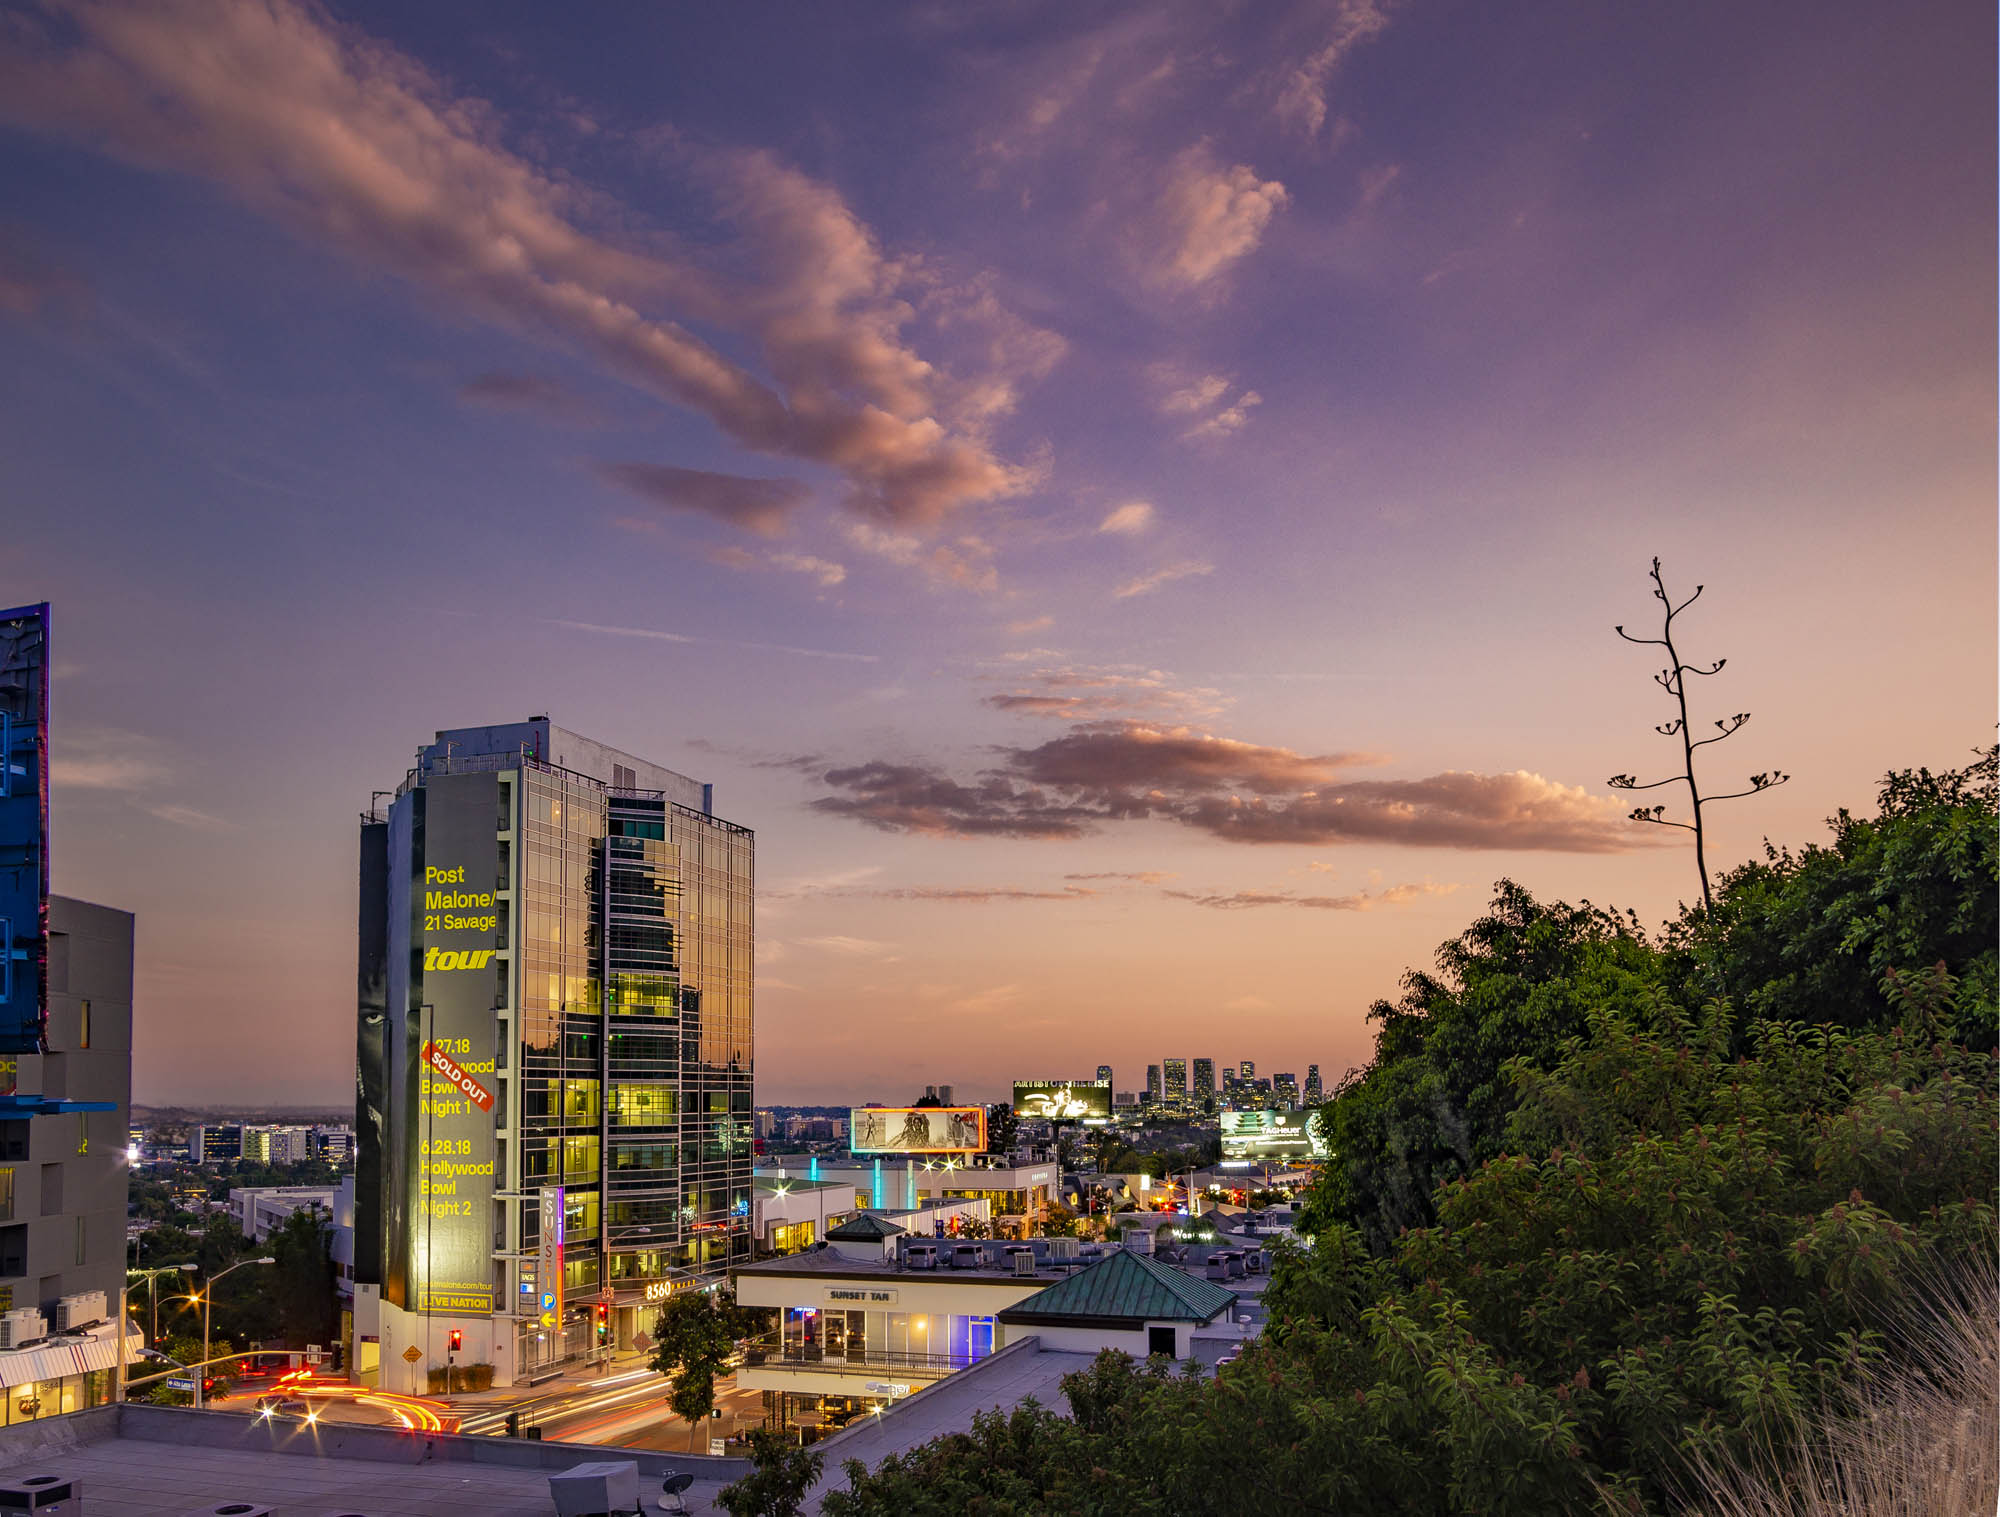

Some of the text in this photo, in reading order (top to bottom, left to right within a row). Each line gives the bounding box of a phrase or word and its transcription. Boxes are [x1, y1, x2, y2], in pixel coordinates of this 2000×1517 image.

[425, 866, 465, 885] Post
[425, 888, 497, 911] Malone/
[424, 914, 496, 932] 21 Savage
[424, 946, 496, 971] tour
[432, 1052, 488, 1104] SOLD OUT
[1088, 1080, 1110, 1088] RISE
[421, 1099, 471, 1118] Night 1
[421, 1139, 472, 1155] 6.28.18
[421, 1159, 494, 1178] Hollywood
[421, 1179, 456, 1195] Bowl
[421, 1199, 472, 1219] Night 2
[543, 1200, 555, 1289] SUNSET
[646, 1281, 671, 1300] 8560
[830, 1290, 889, 1302] SUNSET TAN
[423, 1296, 489, 1309] LIVE NATION
